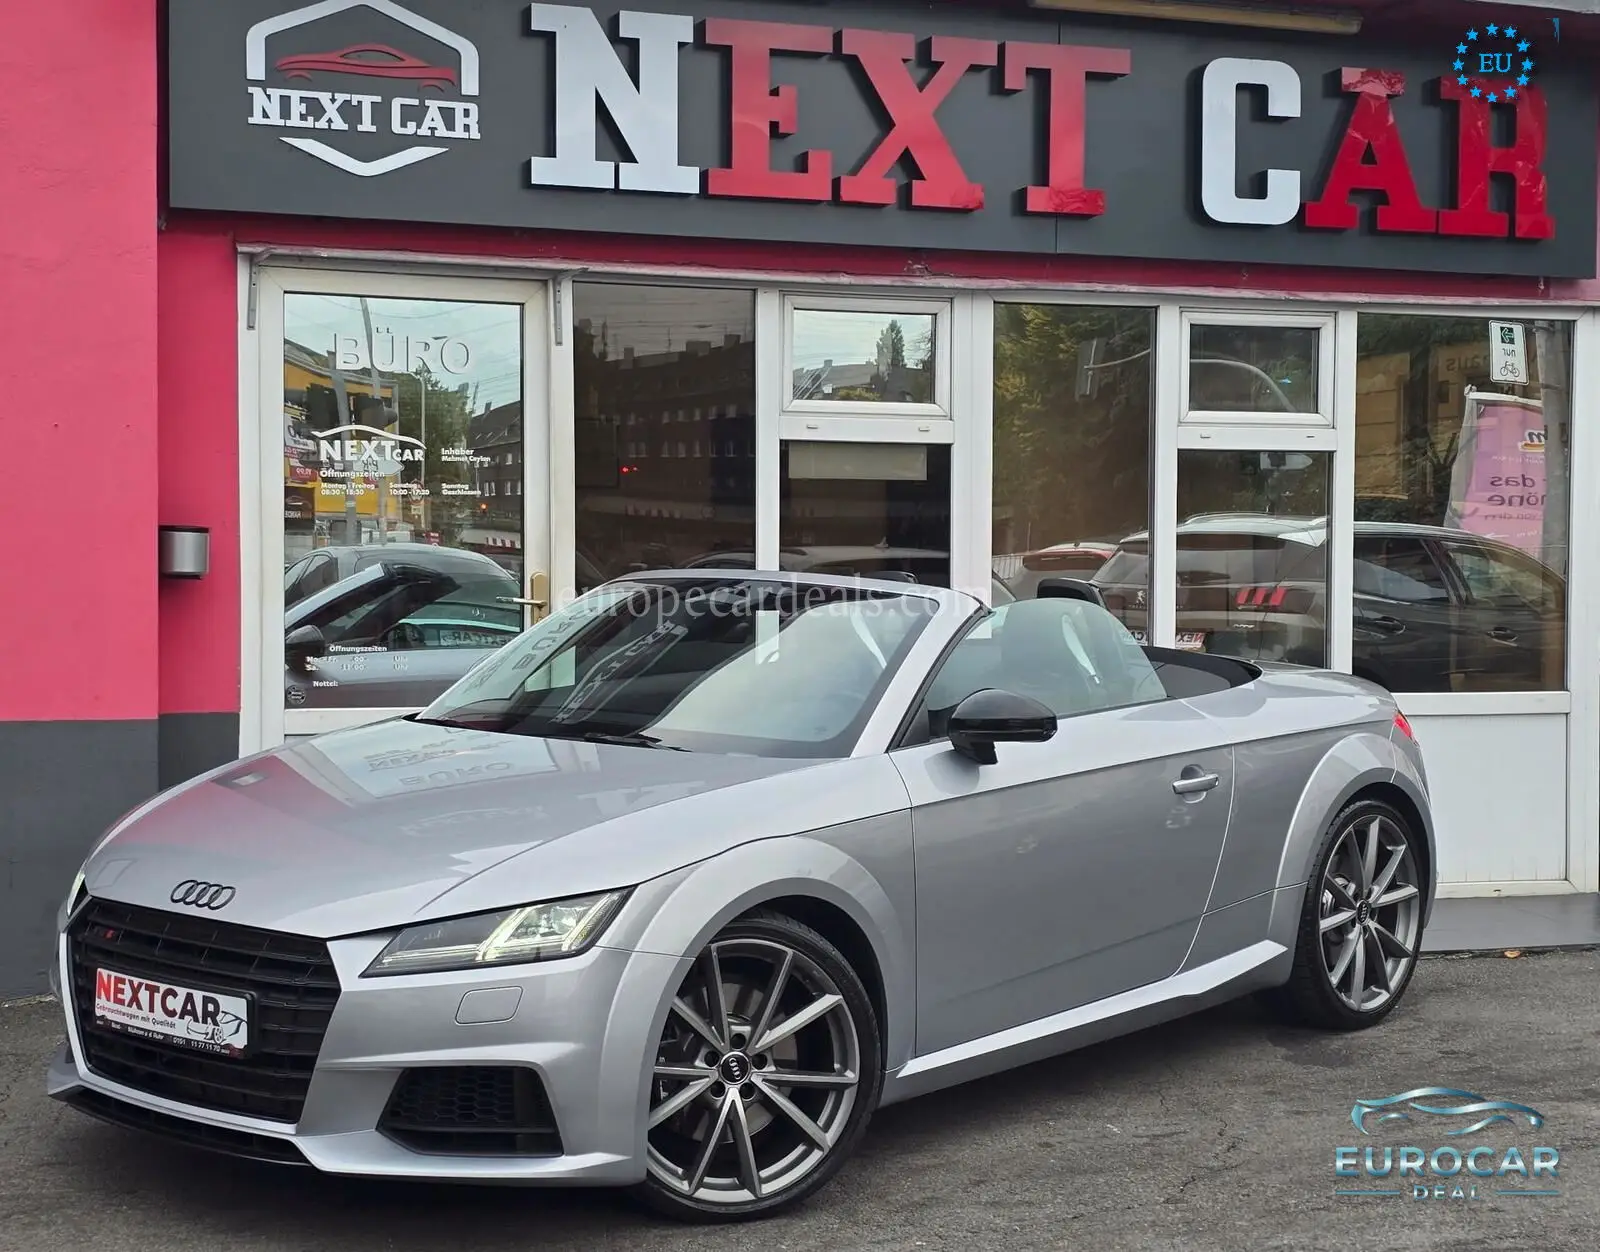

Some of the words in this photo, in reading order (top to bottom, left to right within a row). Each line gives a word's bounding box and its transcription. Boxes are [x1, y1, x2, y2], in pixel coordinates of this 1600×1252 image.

[247, 86, 382, 133] NEXT
[391, 96, 481, 141] CAR
[531, 3, 1131, 215] NEXT
[1202, 56, 1556, 240] CAR
[334, 326, 471, 375] BÜRO
[320, 467, 385, 480] Öffnungszeiten
[441, 447, 475, 455] Inhaber
[96, 970, 221, 1027] NEXTCAR
